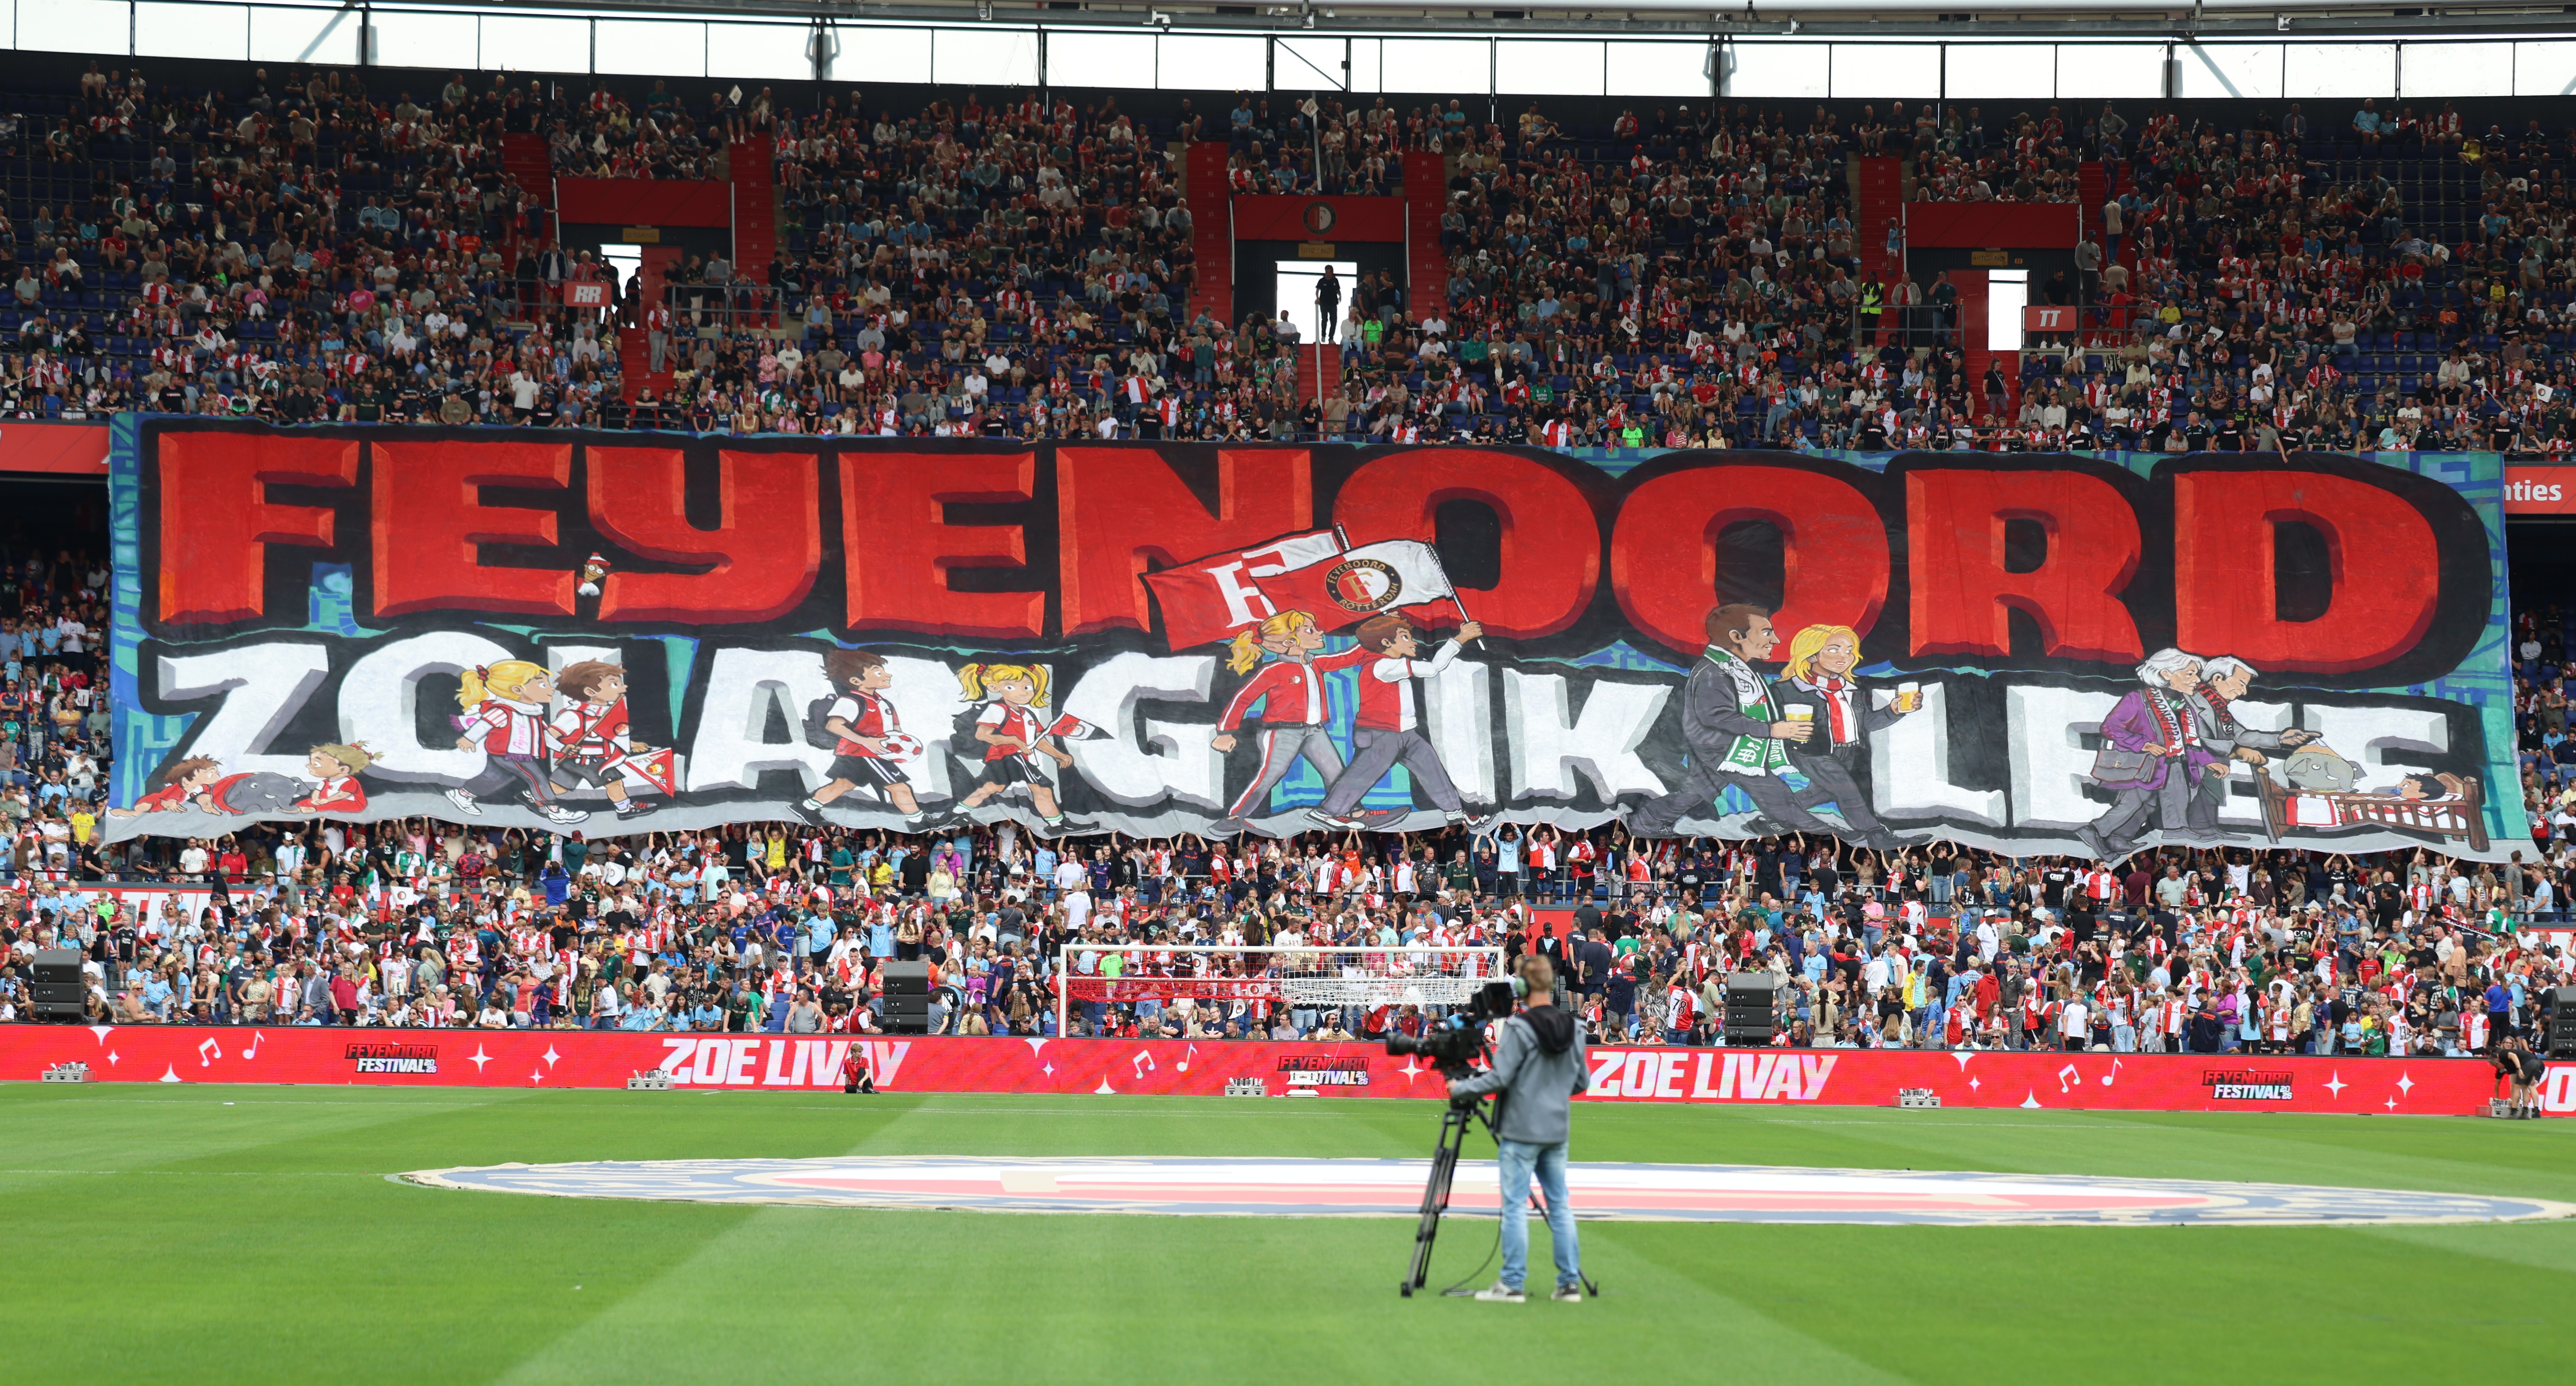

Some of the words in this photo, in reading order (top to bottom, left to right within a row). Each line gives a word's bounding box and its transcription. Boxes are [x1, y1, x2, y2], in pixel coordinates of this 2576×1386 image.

[574, 286, 602, 303] RR
[2039, 310, 2061, 327] TT
[2505, 480, 2562, 501] nties
[158, 430, 2439, 673] FEYENOORD
[1327, 559, 1386, 584] FEYENOORD
[1343, 571, 1374, 601] F
[1338, 582, 1400, 611] ROTTERDAM
[1420, 655, 1674, 808] IK
[1326, 868, 1335, 881] 11
[1672, 997, 1688, 1015] 78
[347, 1044, 437, 1058] FEYENOORD
[356, 1058, 426, 1072] FESTIVAL
[662, 1038, 760, 1085] ZOE
[1279, 1057, 1369, 1071] FEYENOORD
[1590, 1052, 1690, 1097] ZOE
[1692, 1054, 1838, 1100] LIVAY
[2204, 1070, 2293, 1085] FEYENOORD
[2213, 1085, 2281, 1099] FESTIVAL
